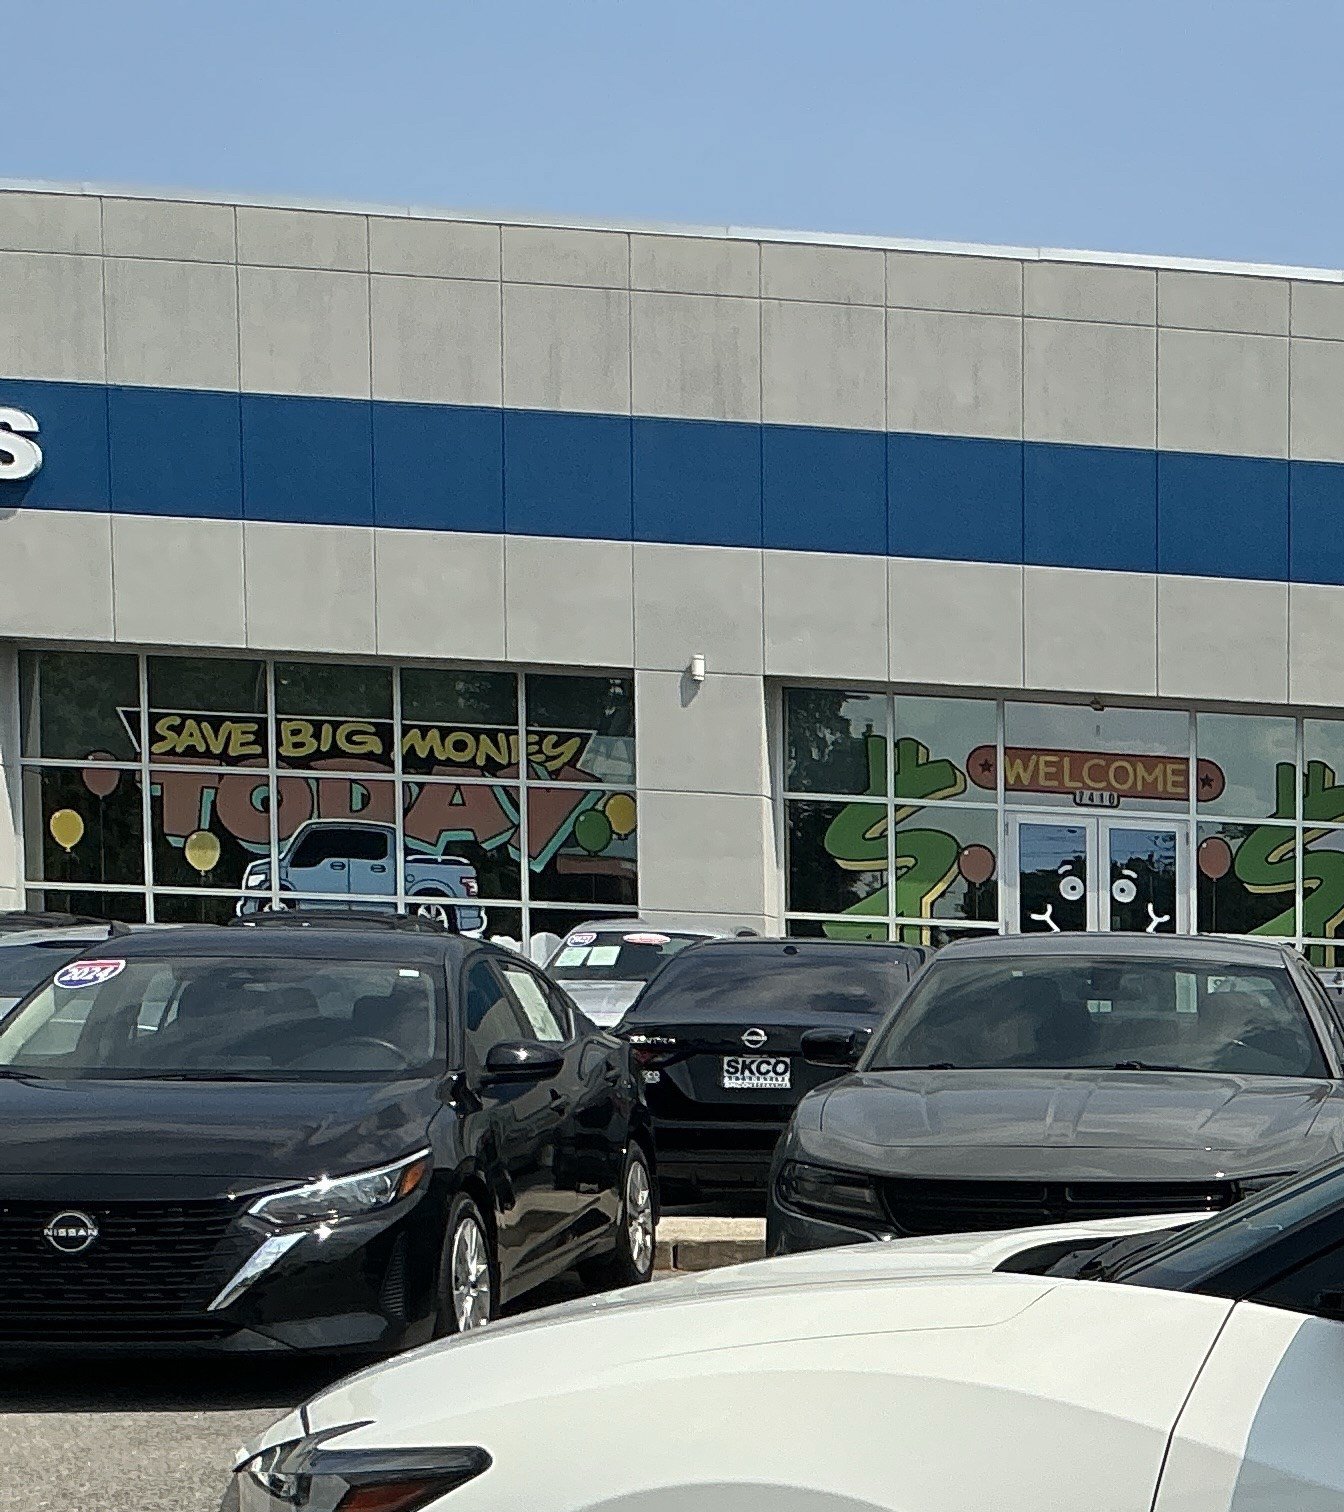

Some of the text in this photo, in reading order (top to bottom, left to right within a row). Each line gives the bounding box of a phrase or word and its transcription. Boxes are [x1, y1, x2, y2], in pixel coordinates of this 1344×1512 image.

[151, 715, 582, 769] SAVE BIG MONEY
[1004, 753, 1187, 794] WELCOME
[136, 755, 604, 868] TODAY
[725, 1058, 790, 1076] SKCO
[43, 1228, 99, 1237] NISSAN
